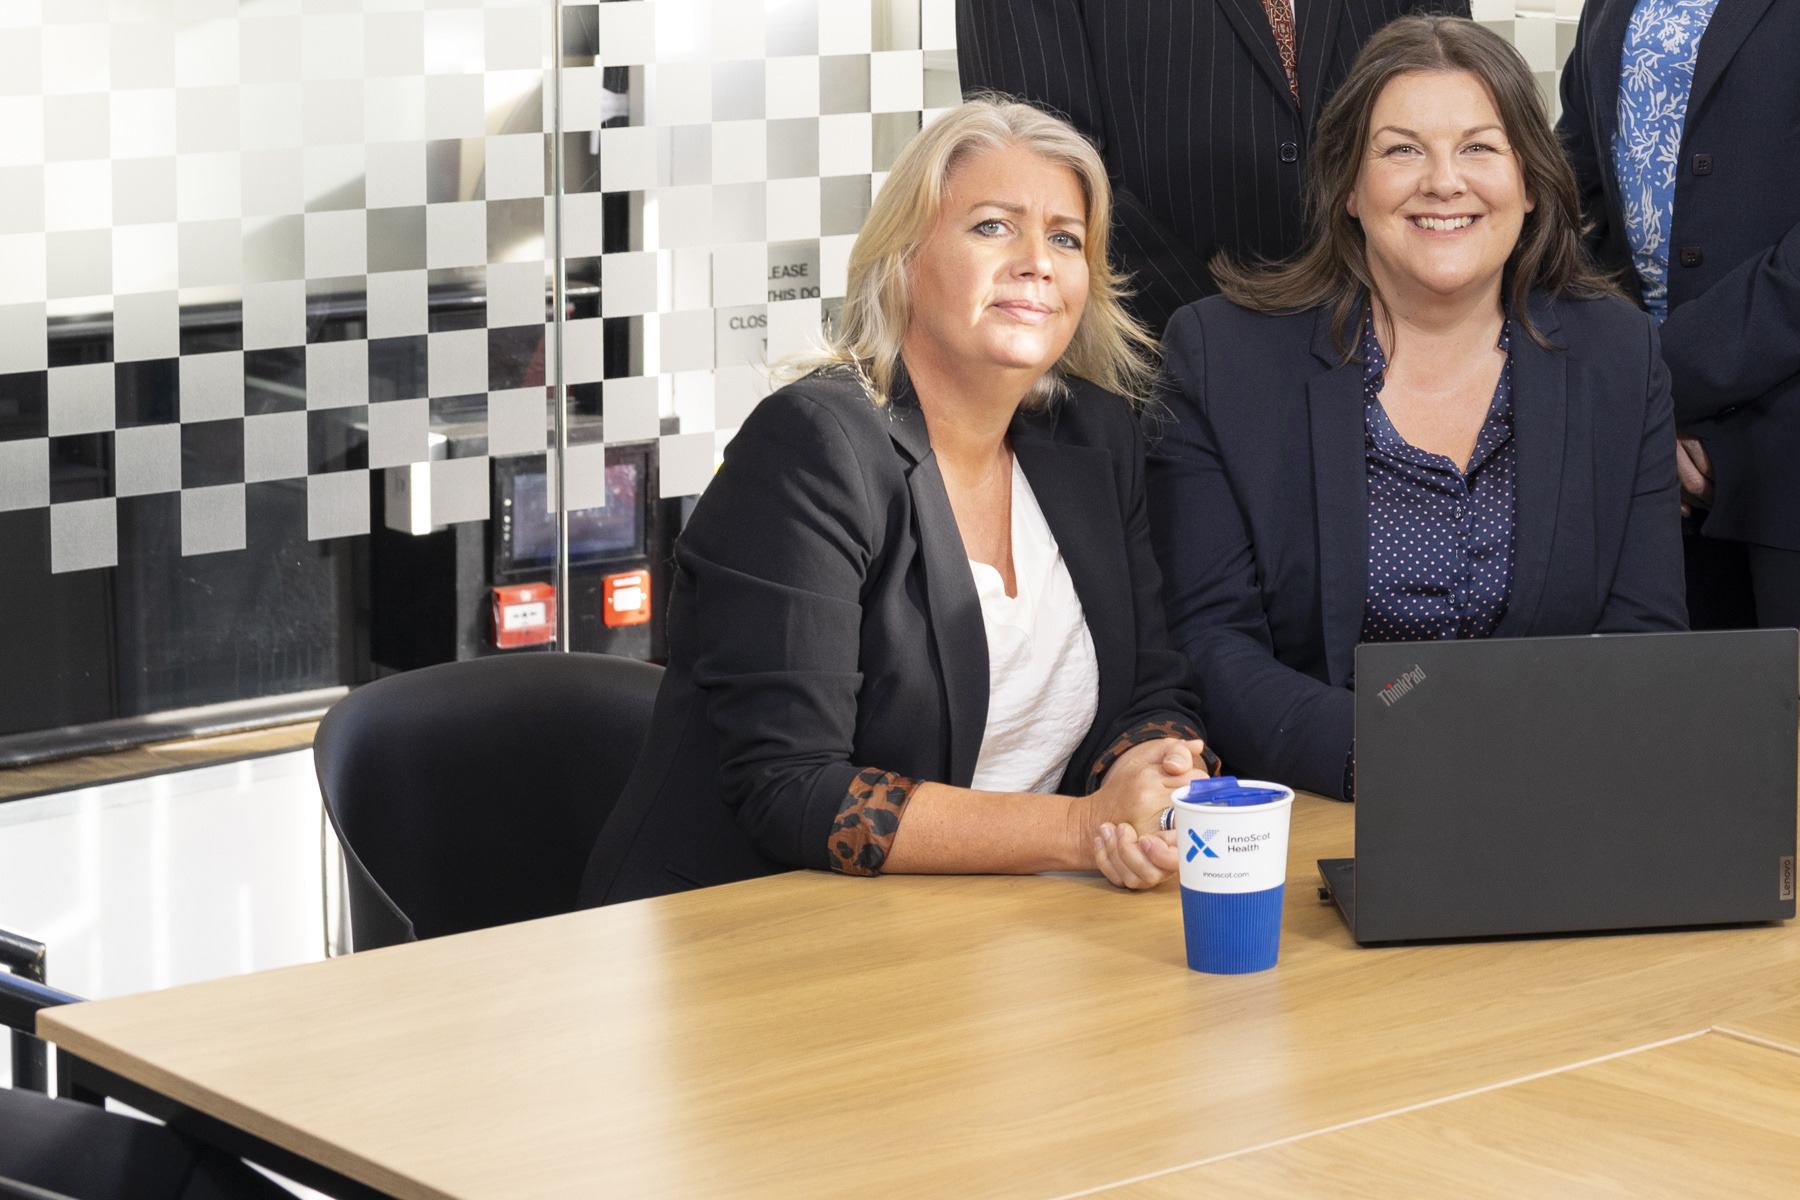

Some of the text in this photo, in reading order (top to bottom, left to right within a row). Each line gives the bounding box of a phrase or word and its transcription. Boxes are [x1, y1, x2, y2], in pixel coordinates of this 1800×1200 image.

[800, 285, 820, 300] DO
[729, 314, 767, 331] CLOS
[1376, 663, 1427, 707] ThinkPad
[1227, 832, 1271, 843] InnoScot
[1227, 843, 1260, 853] Health
[1202, 870, 1250, 879] innoscot.com
[1783, 859, 1791, 896] Lenovo
